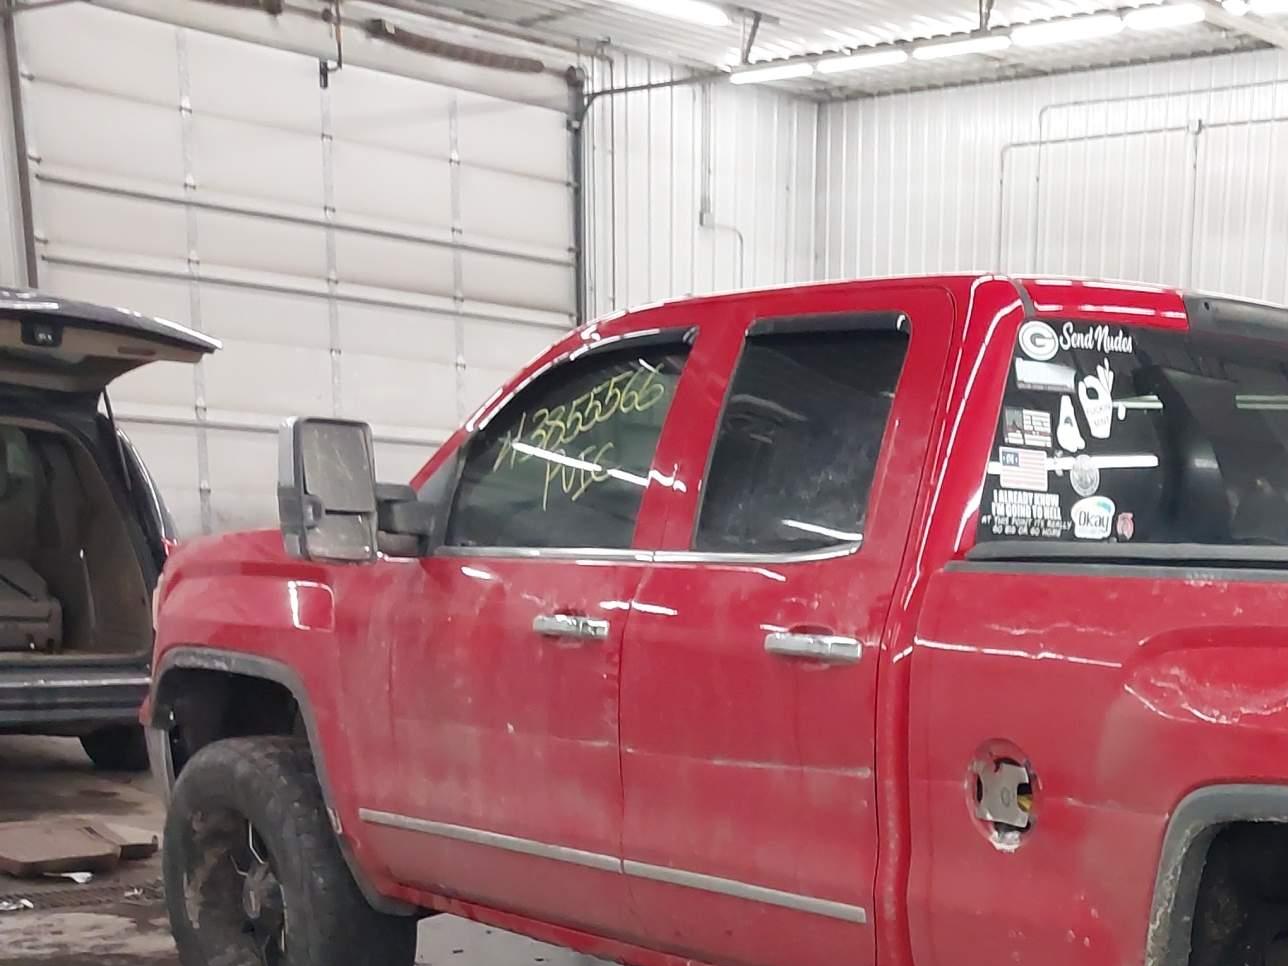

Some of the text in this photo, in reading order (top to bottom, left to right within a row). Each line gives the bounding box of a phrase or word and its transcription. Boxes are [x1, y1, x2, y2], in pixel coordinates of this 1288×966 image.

[1060, 321, 1133, 353] Send Nudes
[1079, 511, 1109, 532] Okay
